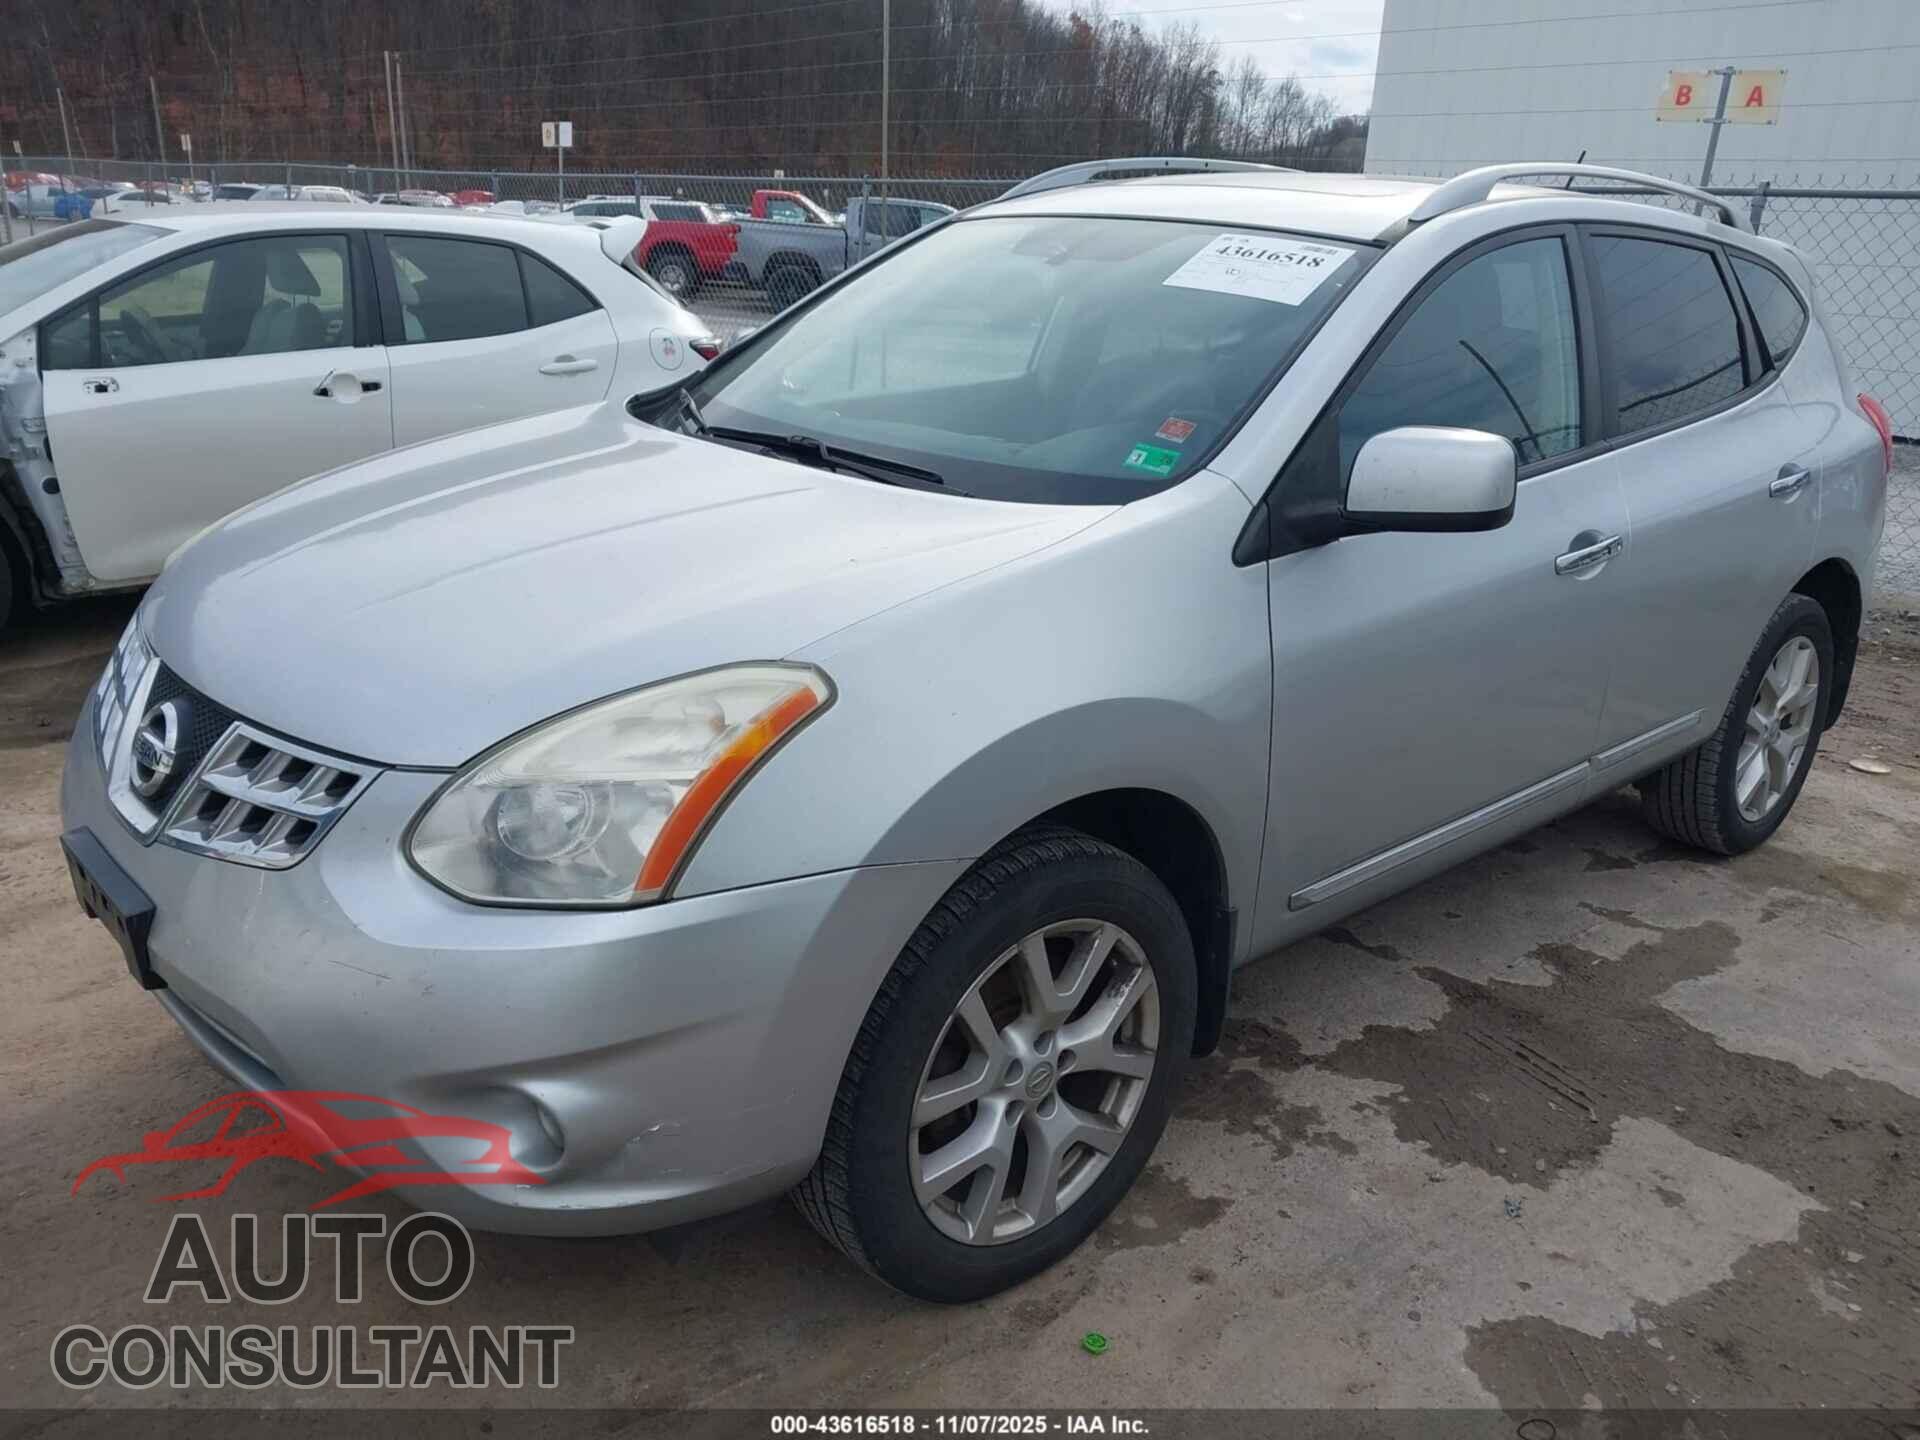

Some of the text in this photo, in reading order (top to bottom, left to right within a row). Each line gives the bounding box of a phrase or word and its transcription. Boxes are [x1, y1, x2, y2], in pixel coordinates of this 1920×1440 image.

[1674, 84, 1692, 106] B
[1744, 85, 1763, 107] A
[1215, 245, 1325, 268] 43616518
